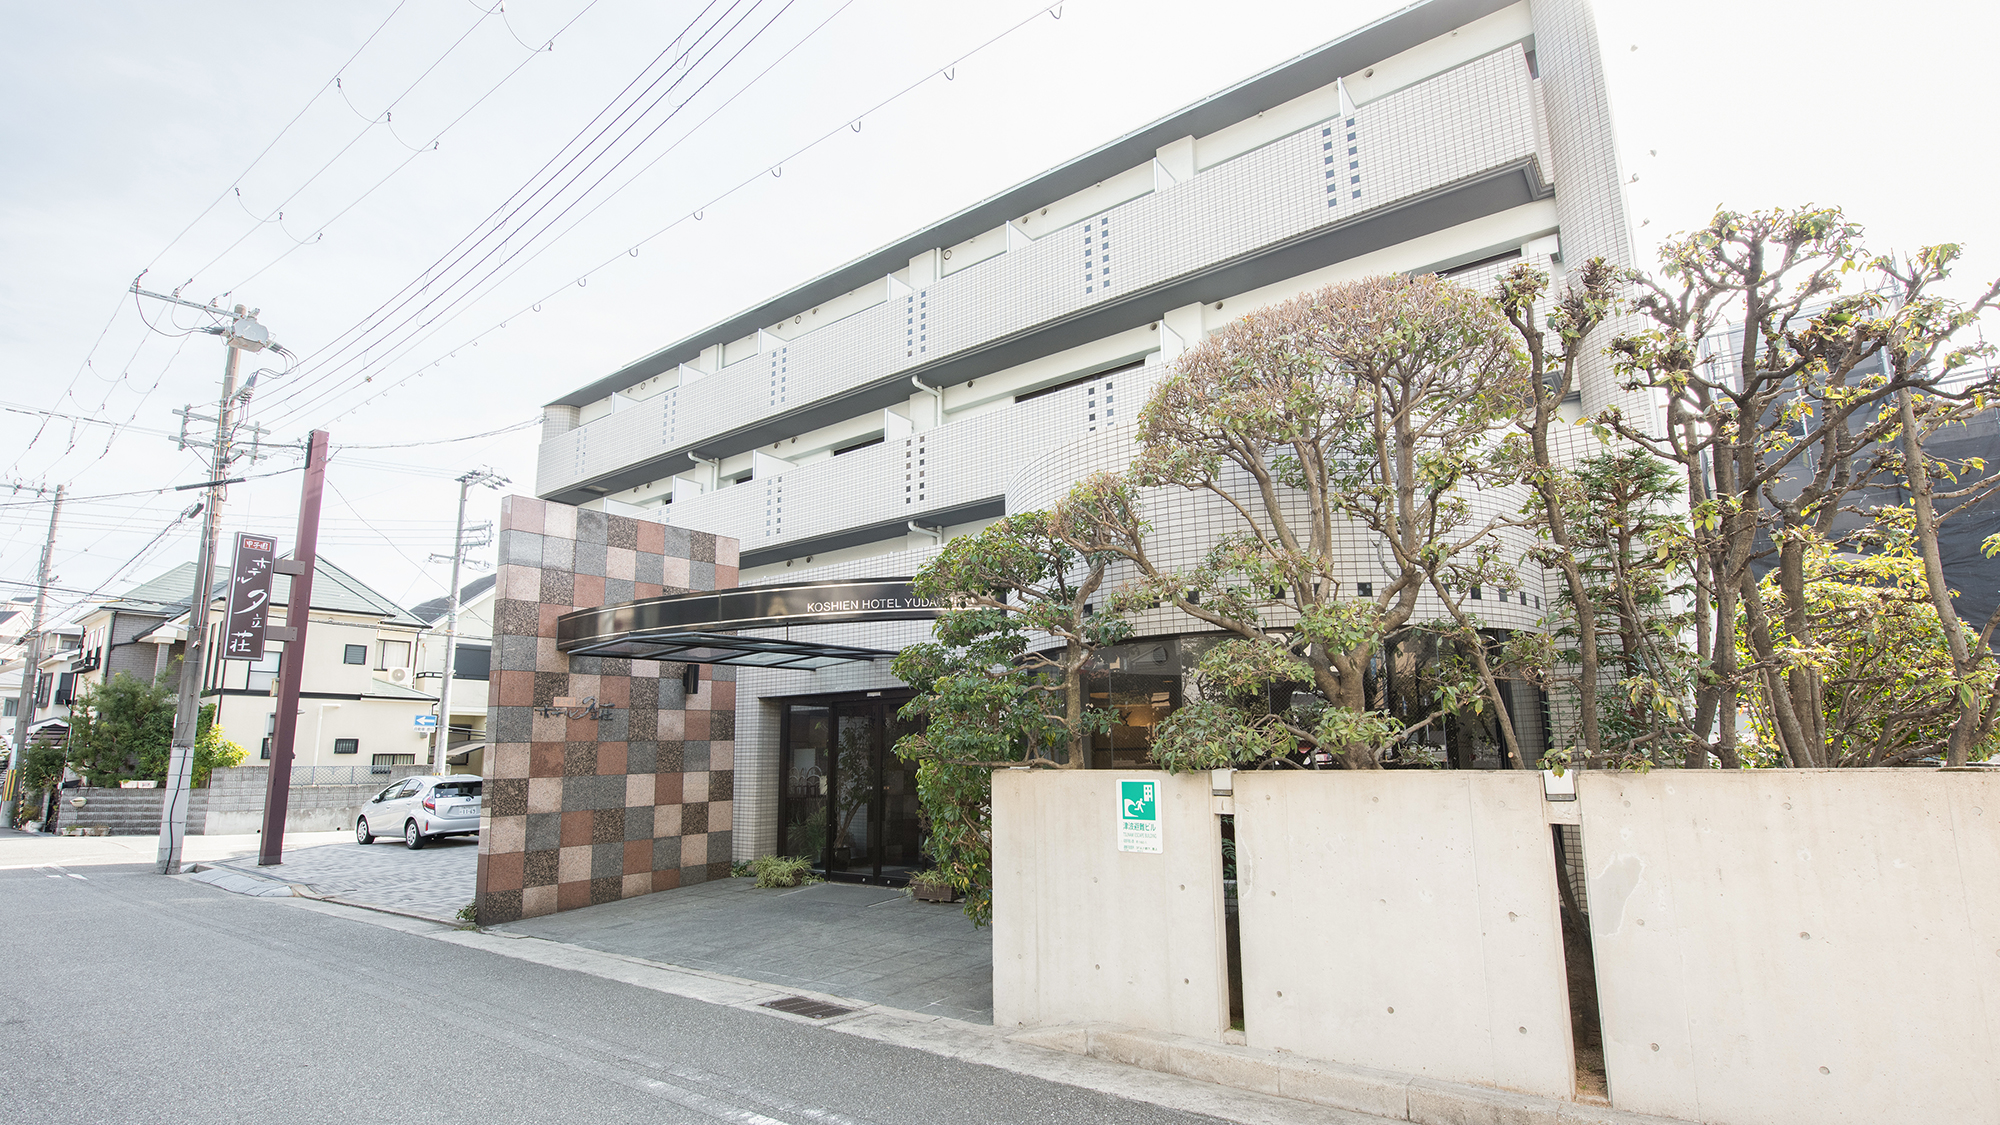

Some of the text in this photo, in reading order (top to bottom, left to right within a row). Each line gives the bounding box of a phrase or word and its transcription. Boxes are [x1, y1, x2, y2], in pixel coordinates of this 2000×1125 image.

[807, 600, 858, 612] KOSHIEN
[862, 598, 901, 609] HOTEL
[1123, 822, 1156, 831] 津波避難ビル
